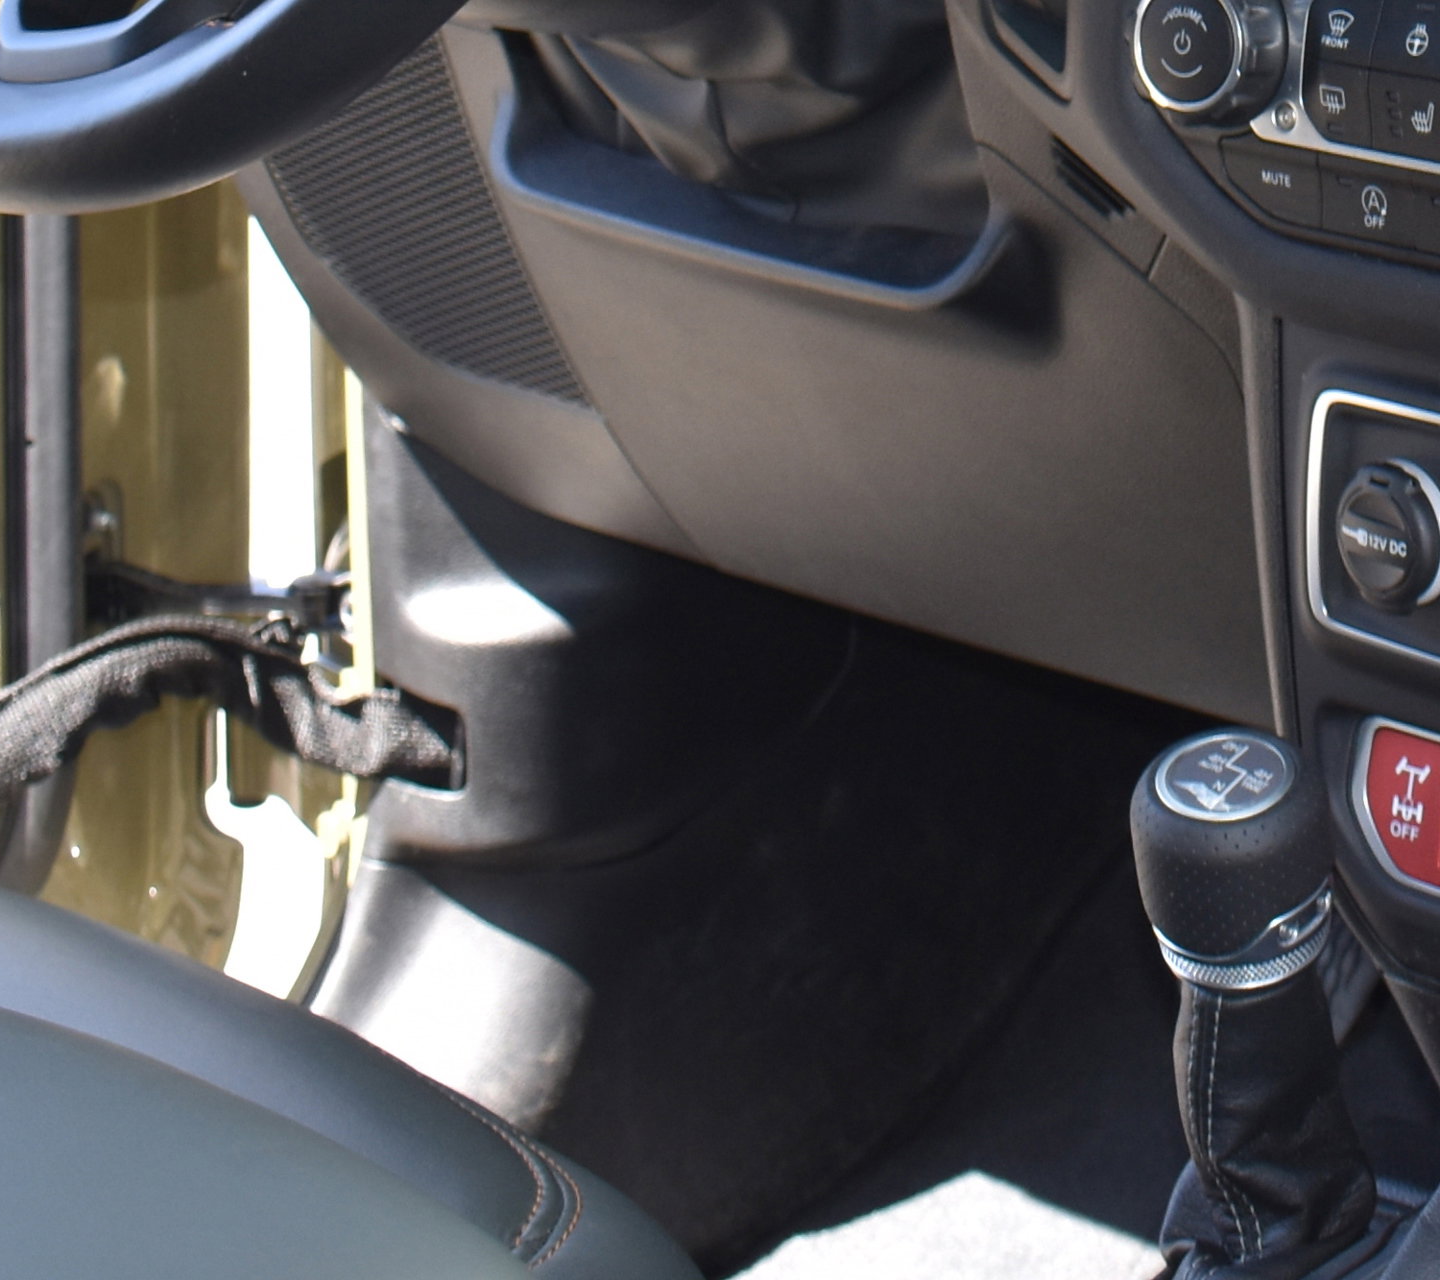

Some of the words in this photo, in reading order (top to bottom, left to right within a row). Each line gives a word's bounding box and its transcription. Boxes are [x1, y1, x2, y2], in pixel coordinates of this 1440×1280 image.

[1167, 5, 1203, 25] VOLUME
[1321, 35, 1349, 49] FRONT
[1262, 170, 1291, 188] MUTE
[1364, 214, 1386, 229] OFF
[1369, 533, 1388, 552] 12V
[1389, 538, 1408, 559] DC
[1213, 780, 1225, 791] N
[1390, 820, 1420, 843] OFF
